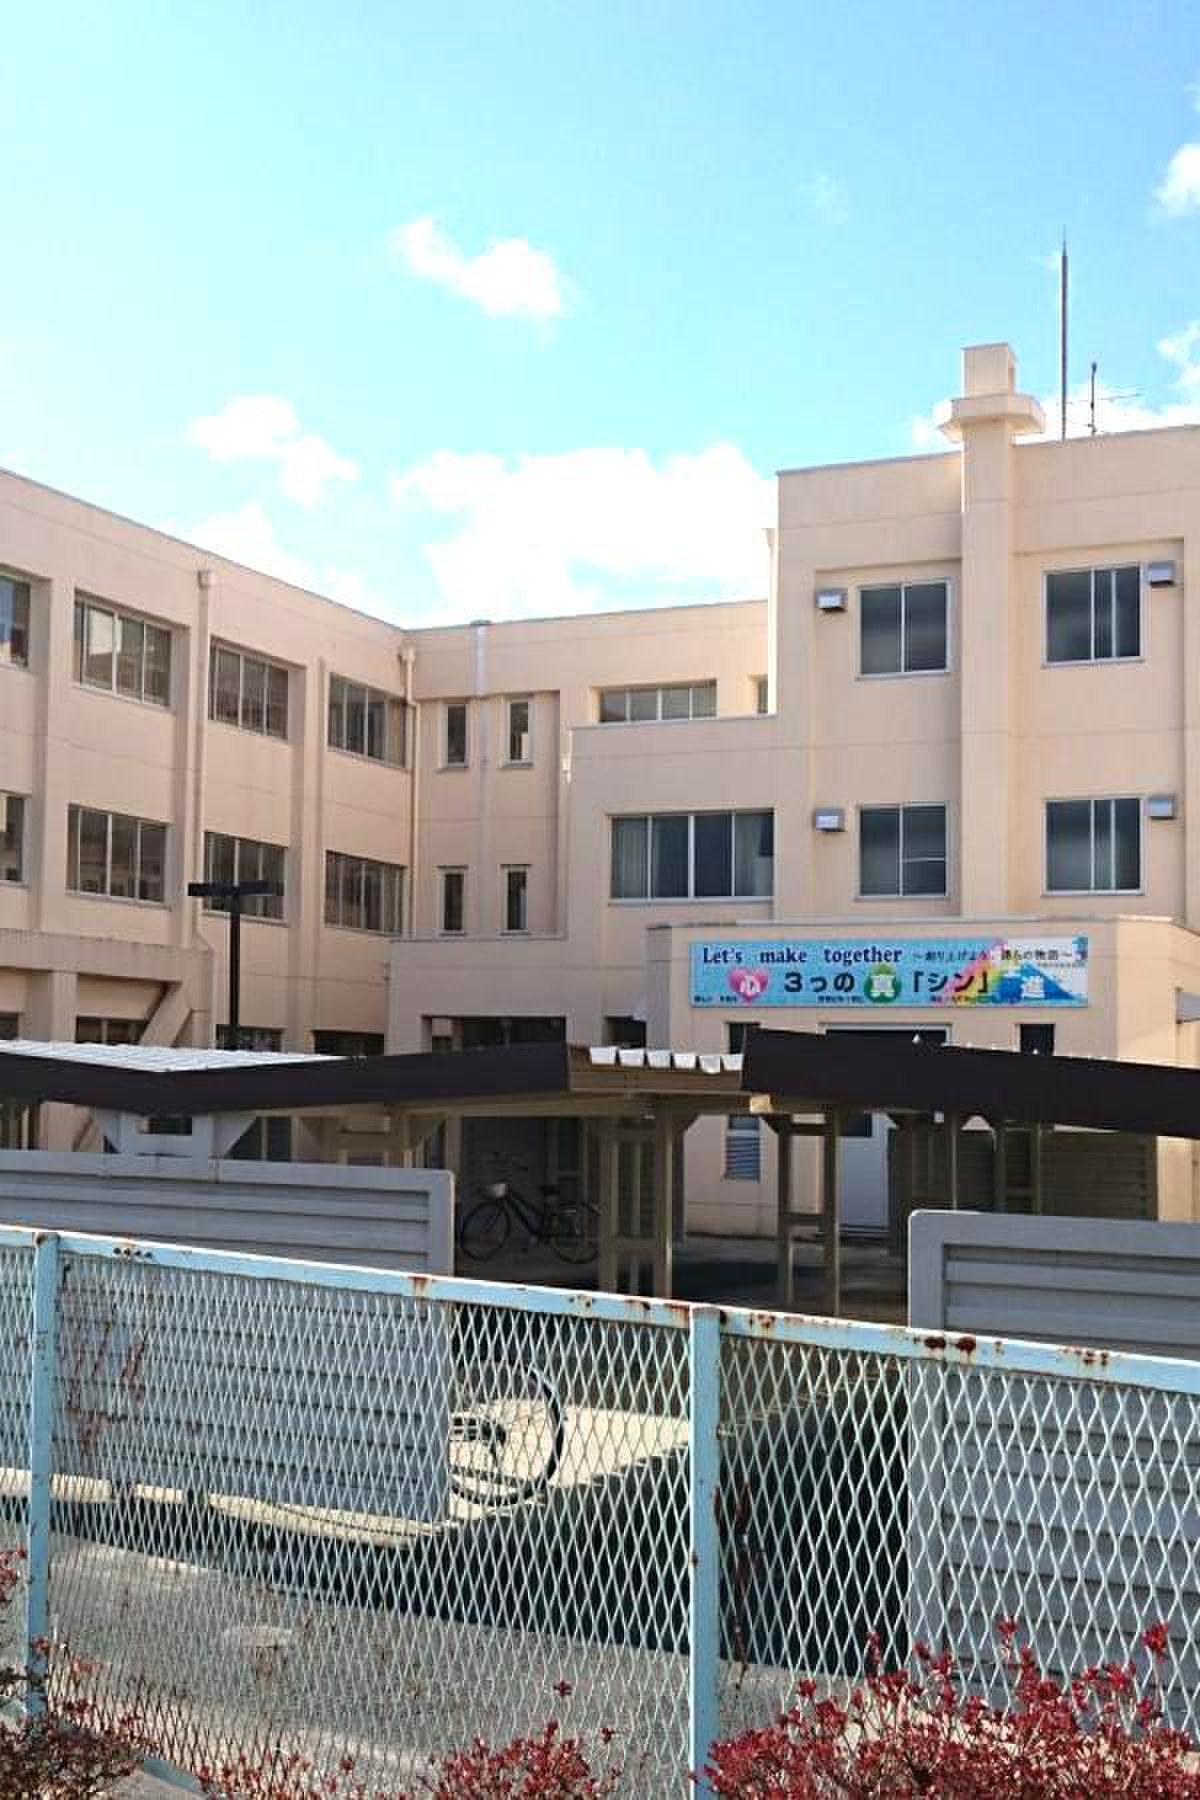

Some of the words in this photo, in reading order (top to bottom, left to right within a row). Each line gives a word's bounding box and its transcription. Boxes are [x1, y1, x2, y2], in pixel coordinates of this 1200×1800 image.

[703, 947, 742, 964] Let's
[760, 948, 807, 964] make
[824, 946, 903, 966] together
